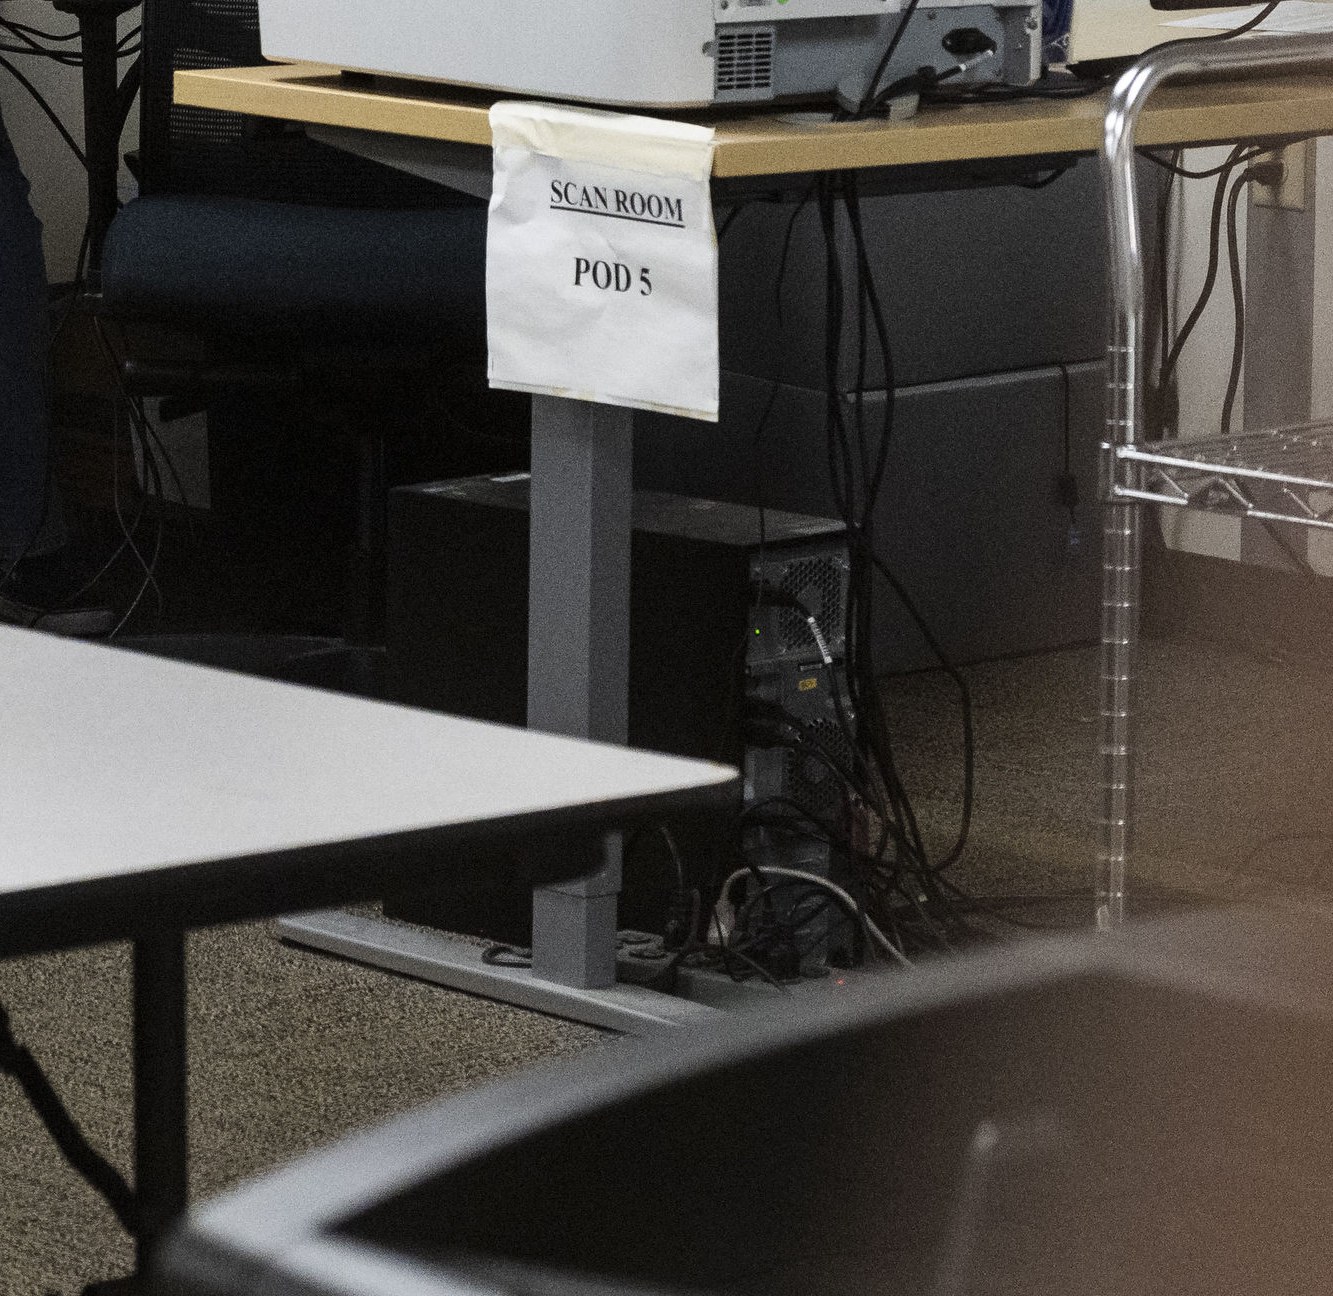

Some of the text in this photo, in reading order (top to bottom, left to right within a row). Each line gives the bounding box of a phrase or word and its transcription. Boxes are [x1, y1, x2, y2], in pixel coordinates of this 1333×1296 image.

[550, 179, 684, 222] SCAN ROOM
[573, 256, 653, 296] POD 5
